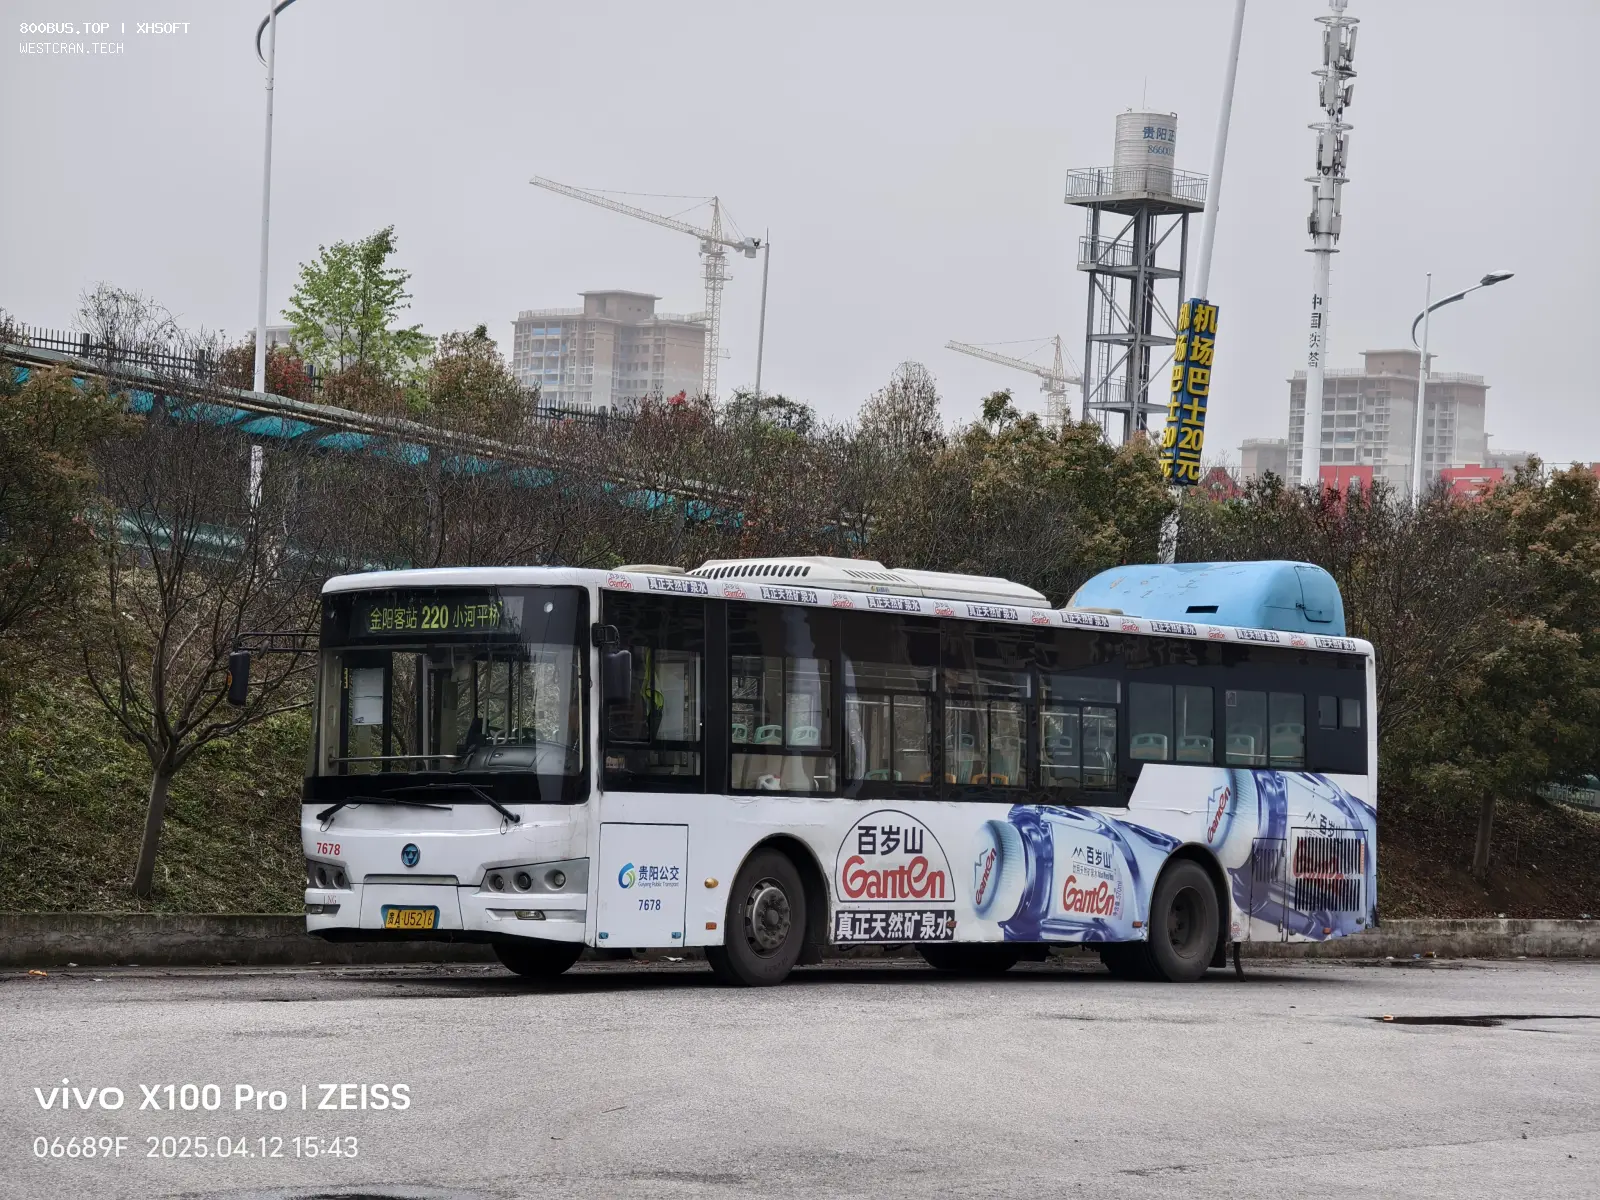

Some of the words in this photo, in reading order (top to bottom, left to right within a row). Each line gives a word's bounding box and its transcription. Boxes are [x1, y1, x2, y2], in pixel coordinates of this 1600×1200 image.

[1177, 303, 1218, 480] 机场巴士20元
[648, 576, 707, 594] 真正天然矿泉水
[370, 606, 417, 630] 金阳客站
[421, 605, 449, 629] 220
[316, 842, 341, 856] 7678
[857, 824, 924, 856] 百岁山
[1086, 846, 1112, 869] 百岁山
[638, 865, 680, 880] 贵阳公交
[638, 899, 661, 911] 7678
[836, 911, 953, 940] 真正天然矿泉水
